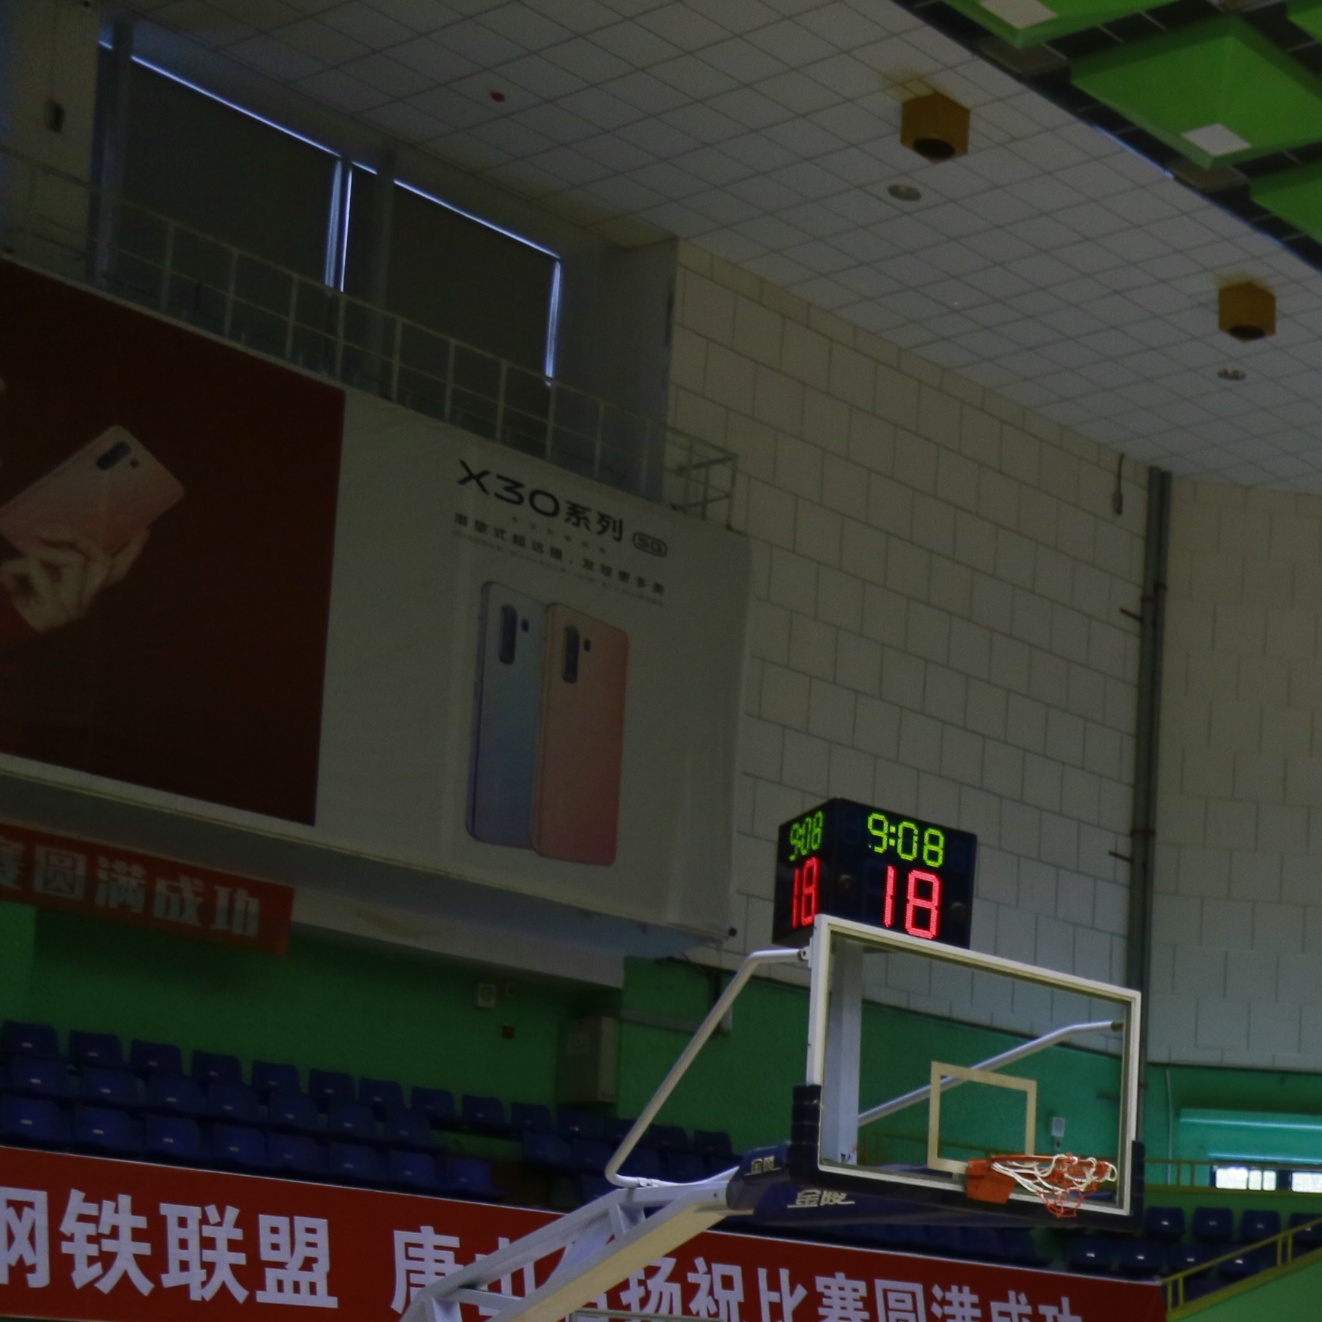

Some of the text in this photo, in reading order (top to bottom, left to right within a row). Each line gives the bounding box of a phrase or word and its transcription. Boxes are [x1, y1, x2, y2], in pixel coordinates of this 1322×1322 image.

[457, 459, 624, 543] X30系列
[788, 811, 824, 862] 9:08
[867, 812, 945, 868] 9:08
[791, 856, 821, 930] 18
[882, 864, 943, 941] 18
